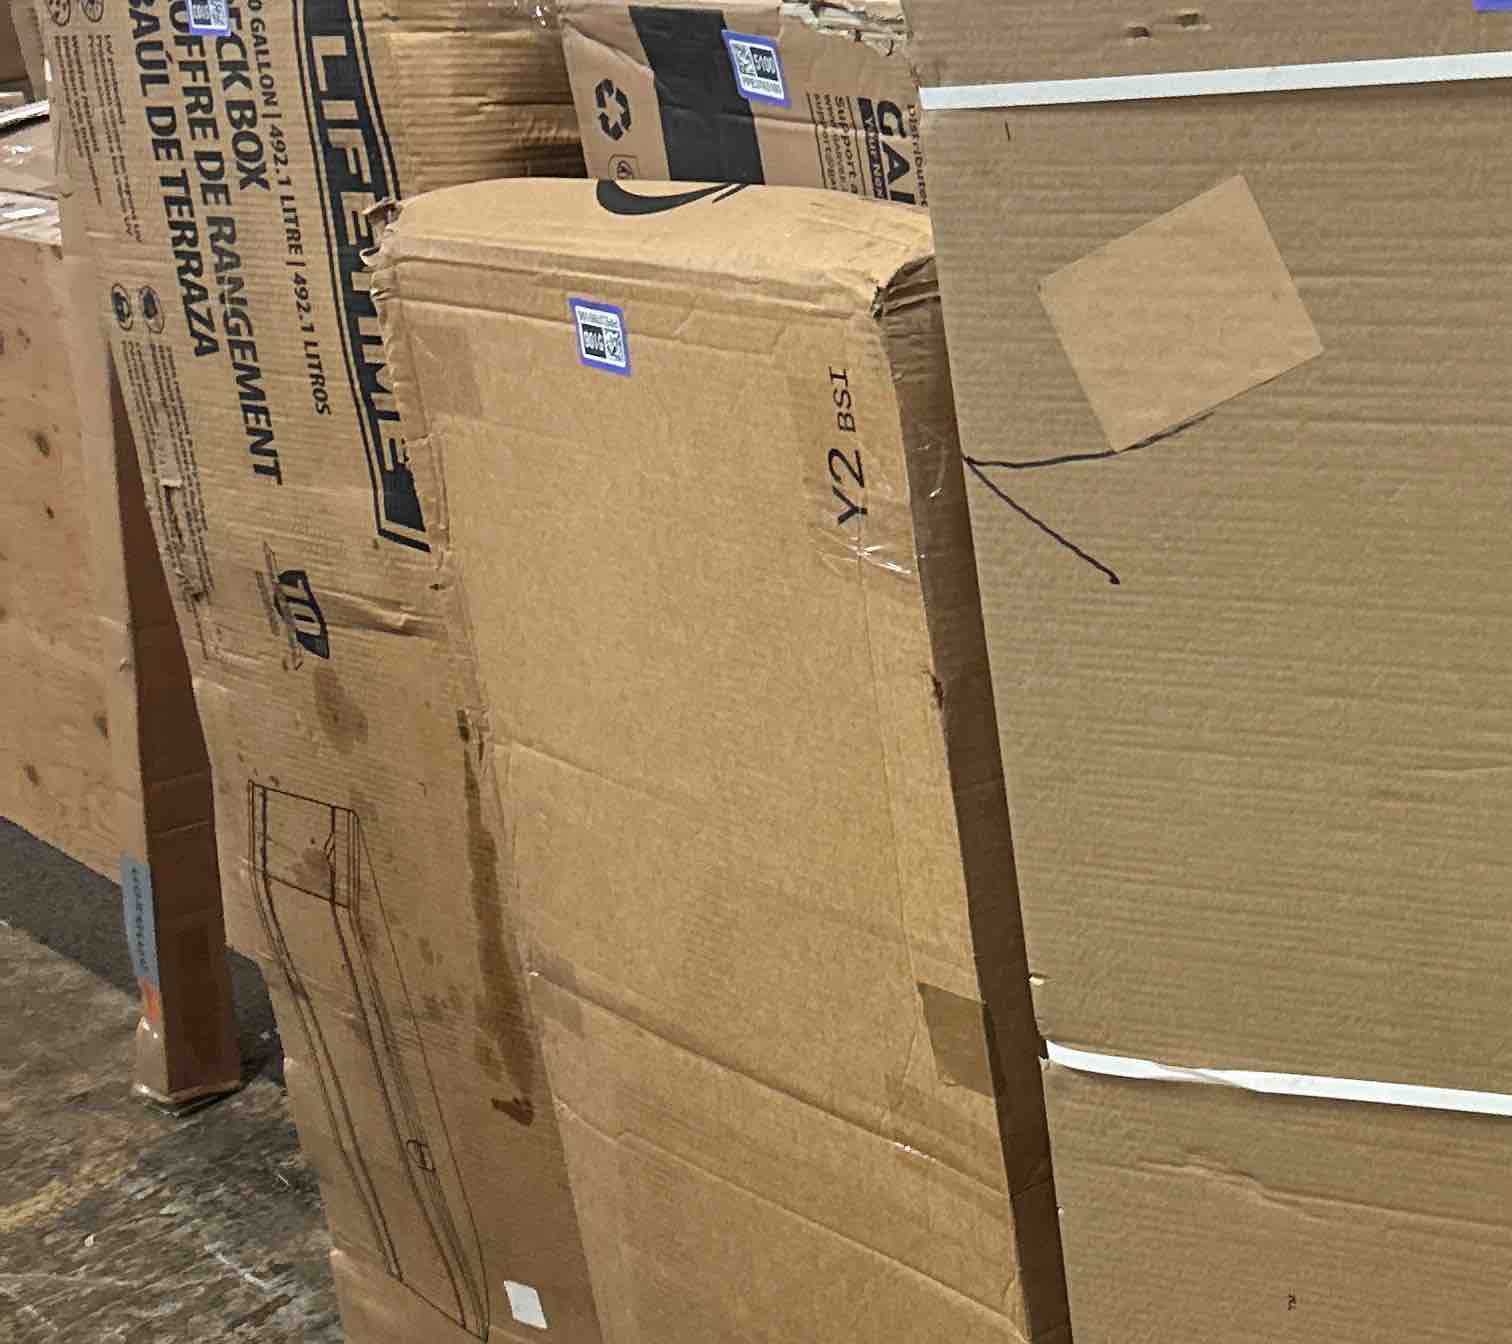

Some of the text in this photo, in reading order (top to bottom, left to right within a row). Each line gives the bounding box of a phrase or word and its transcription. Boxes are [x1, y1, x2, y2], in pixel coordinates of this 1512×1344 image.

[250, 18, 278, 107] GALLON
[145, 106, 184, 161] DE
[225, 99, 271, 191] BOX
[269, 124, 292, 186] 492.1
[193, 150, 232, 206] DE
[280, 194, 303, 255] LITRE
[159, 168, 220, 358] TERRAZA
[293, 271, 315, 334] 492.1
[206, 215, 283, 486] RANGEMENT
[304, 340, 332, 416] LITROS
[827, 447, 868, 526] Y2
